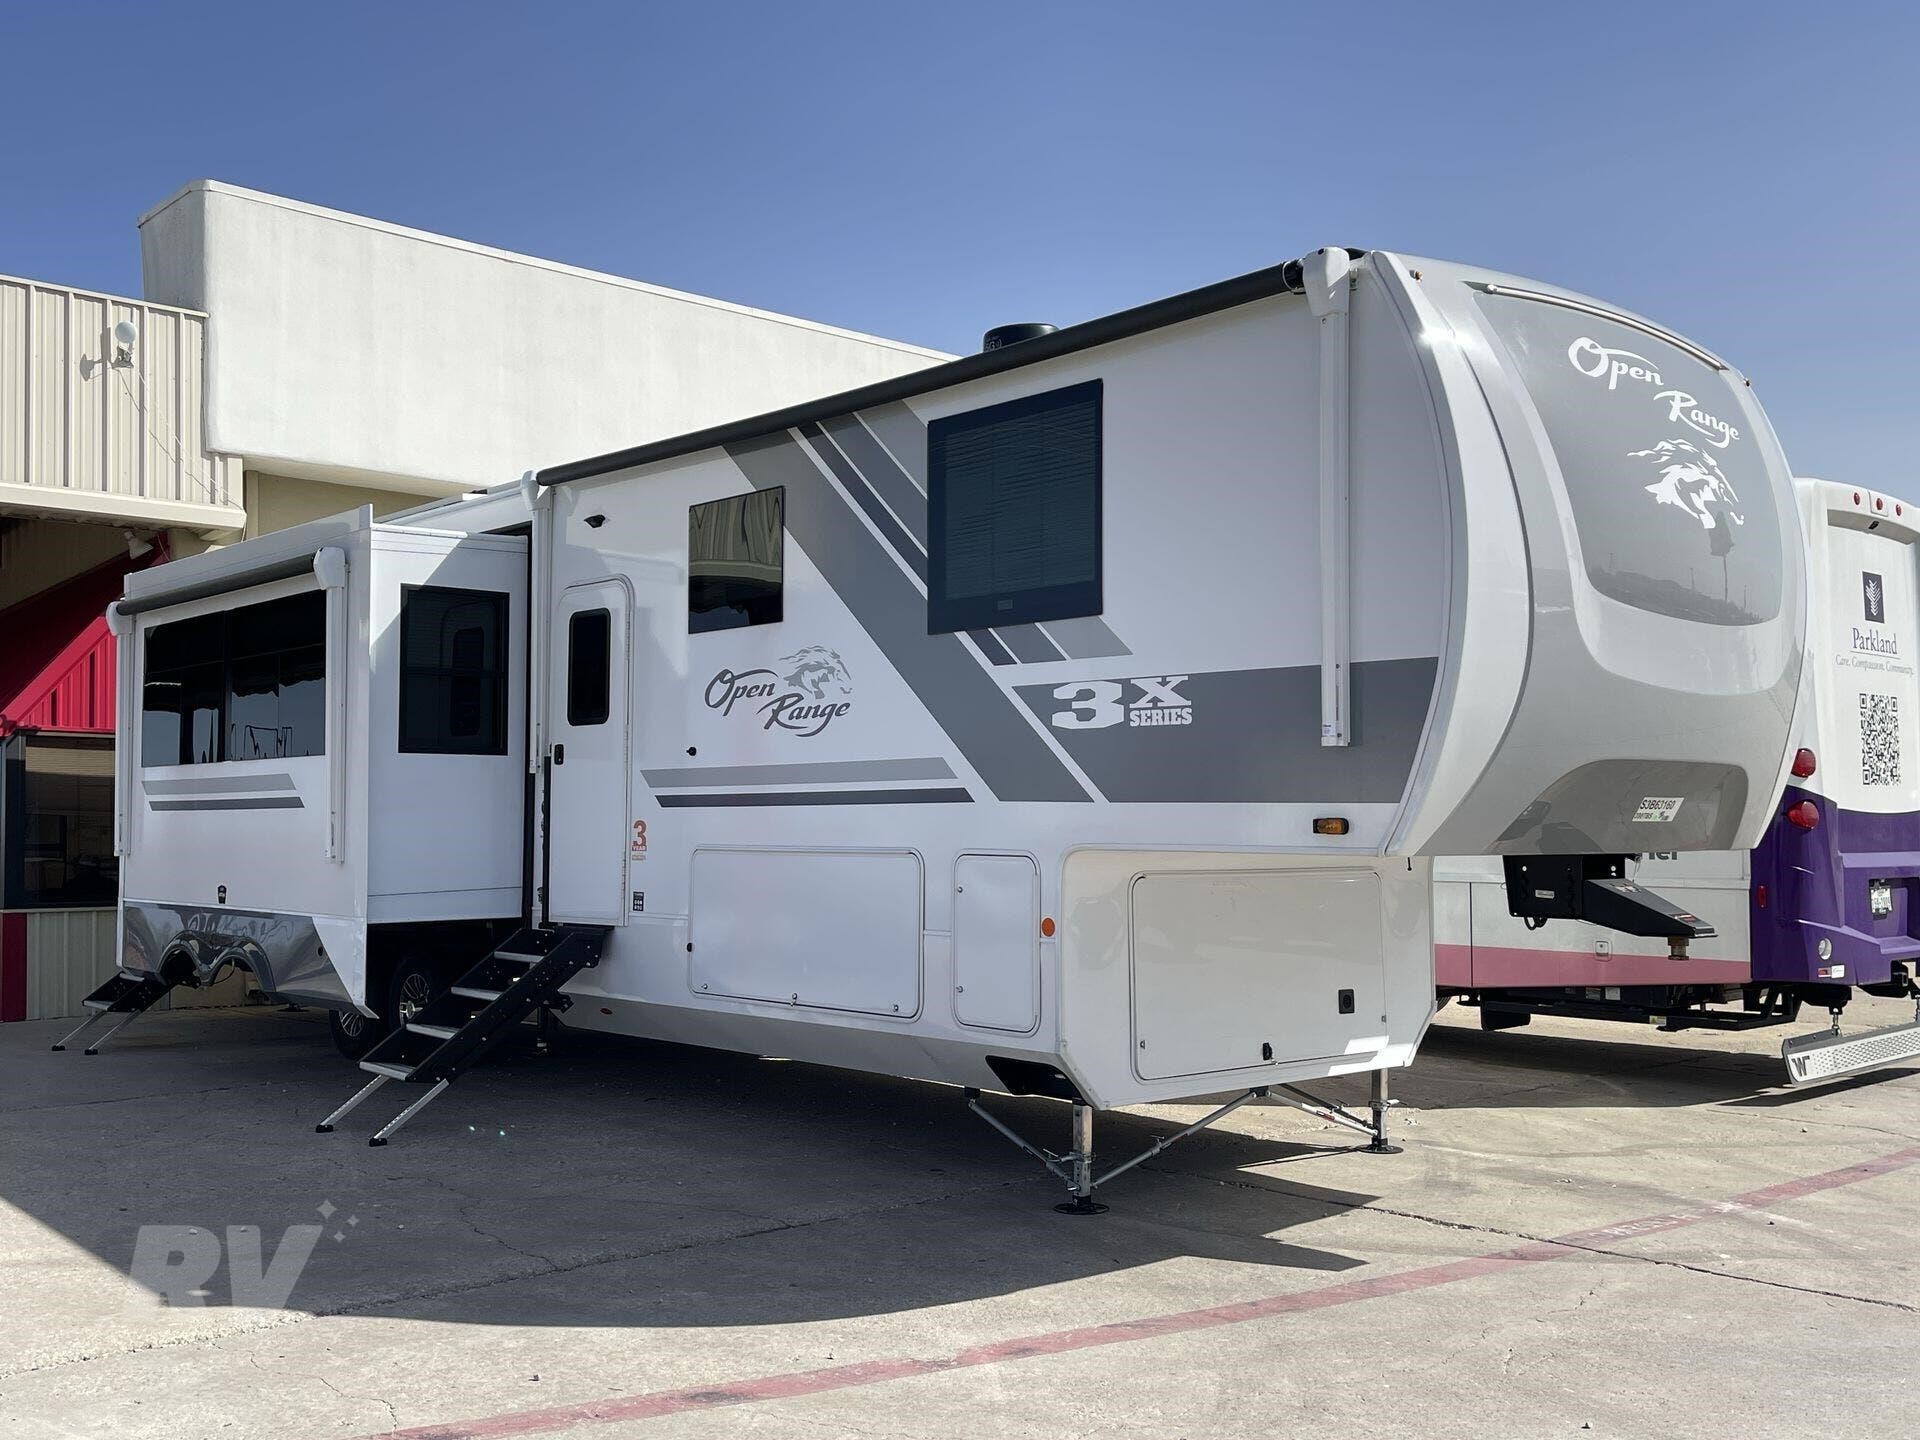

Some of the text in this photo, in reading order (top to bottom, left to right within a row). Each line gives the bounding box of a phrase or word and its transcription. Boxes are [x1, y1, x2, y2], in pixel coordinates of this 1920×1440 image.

[1568, 336, 1664, 390] Open
[1653, 390, 1740, 448] Range
[1852, 627, 1898, 655] Parkland
[705, 668, 779, 716] Open
[756, 692, 851, 738] Range
[1129, 707, 1193, 727] SERIES
[633, 820, 647, 846] 3
